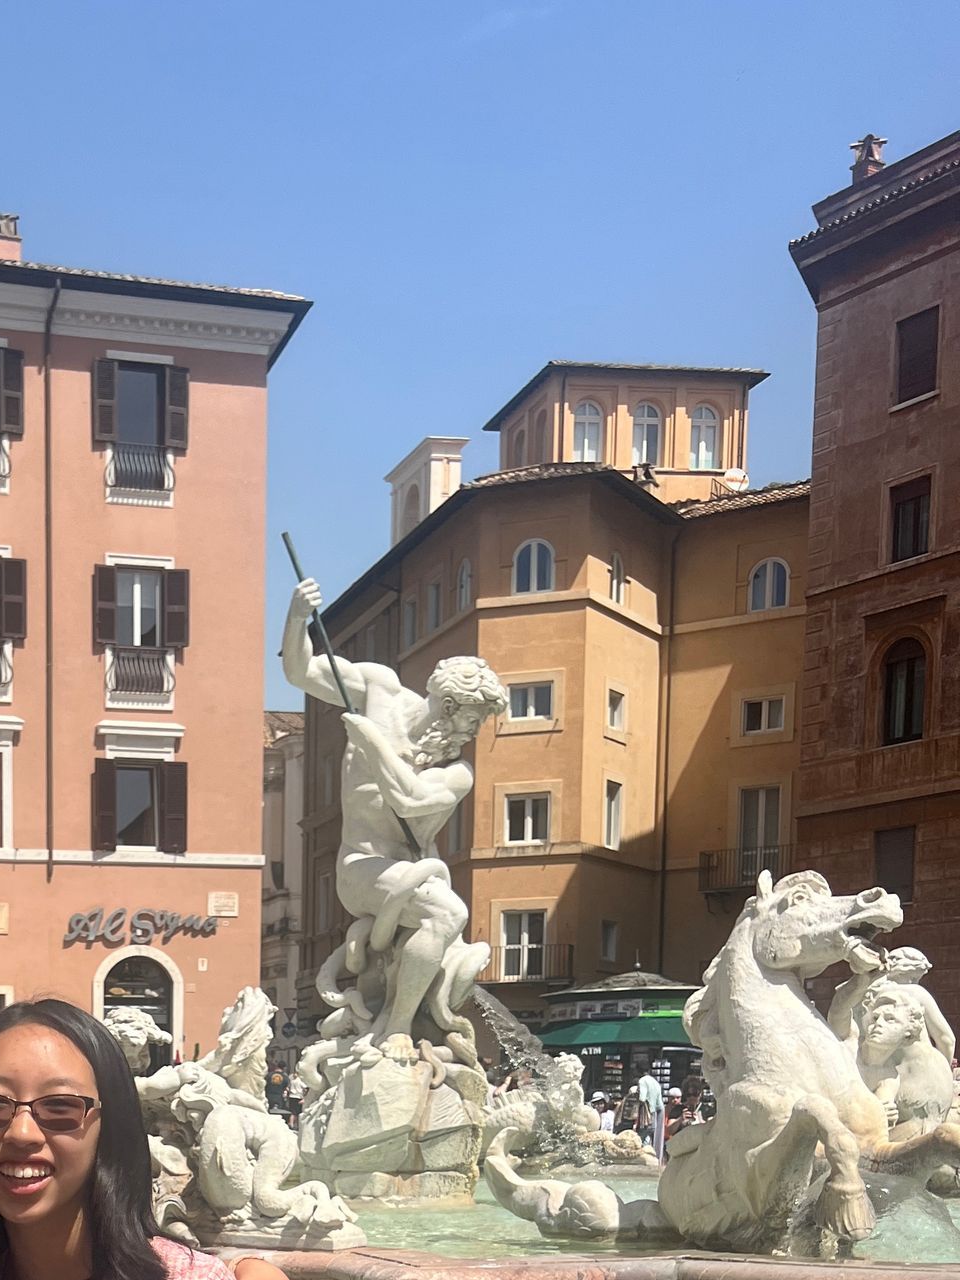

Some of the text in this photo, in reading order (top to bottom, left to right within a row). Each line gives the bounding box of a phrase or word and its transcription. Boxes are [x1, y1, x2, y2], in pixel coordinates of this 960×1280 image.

[64, 907, 218, 945] Al Sogno
[581, 1046, 602, 1056] ATM
